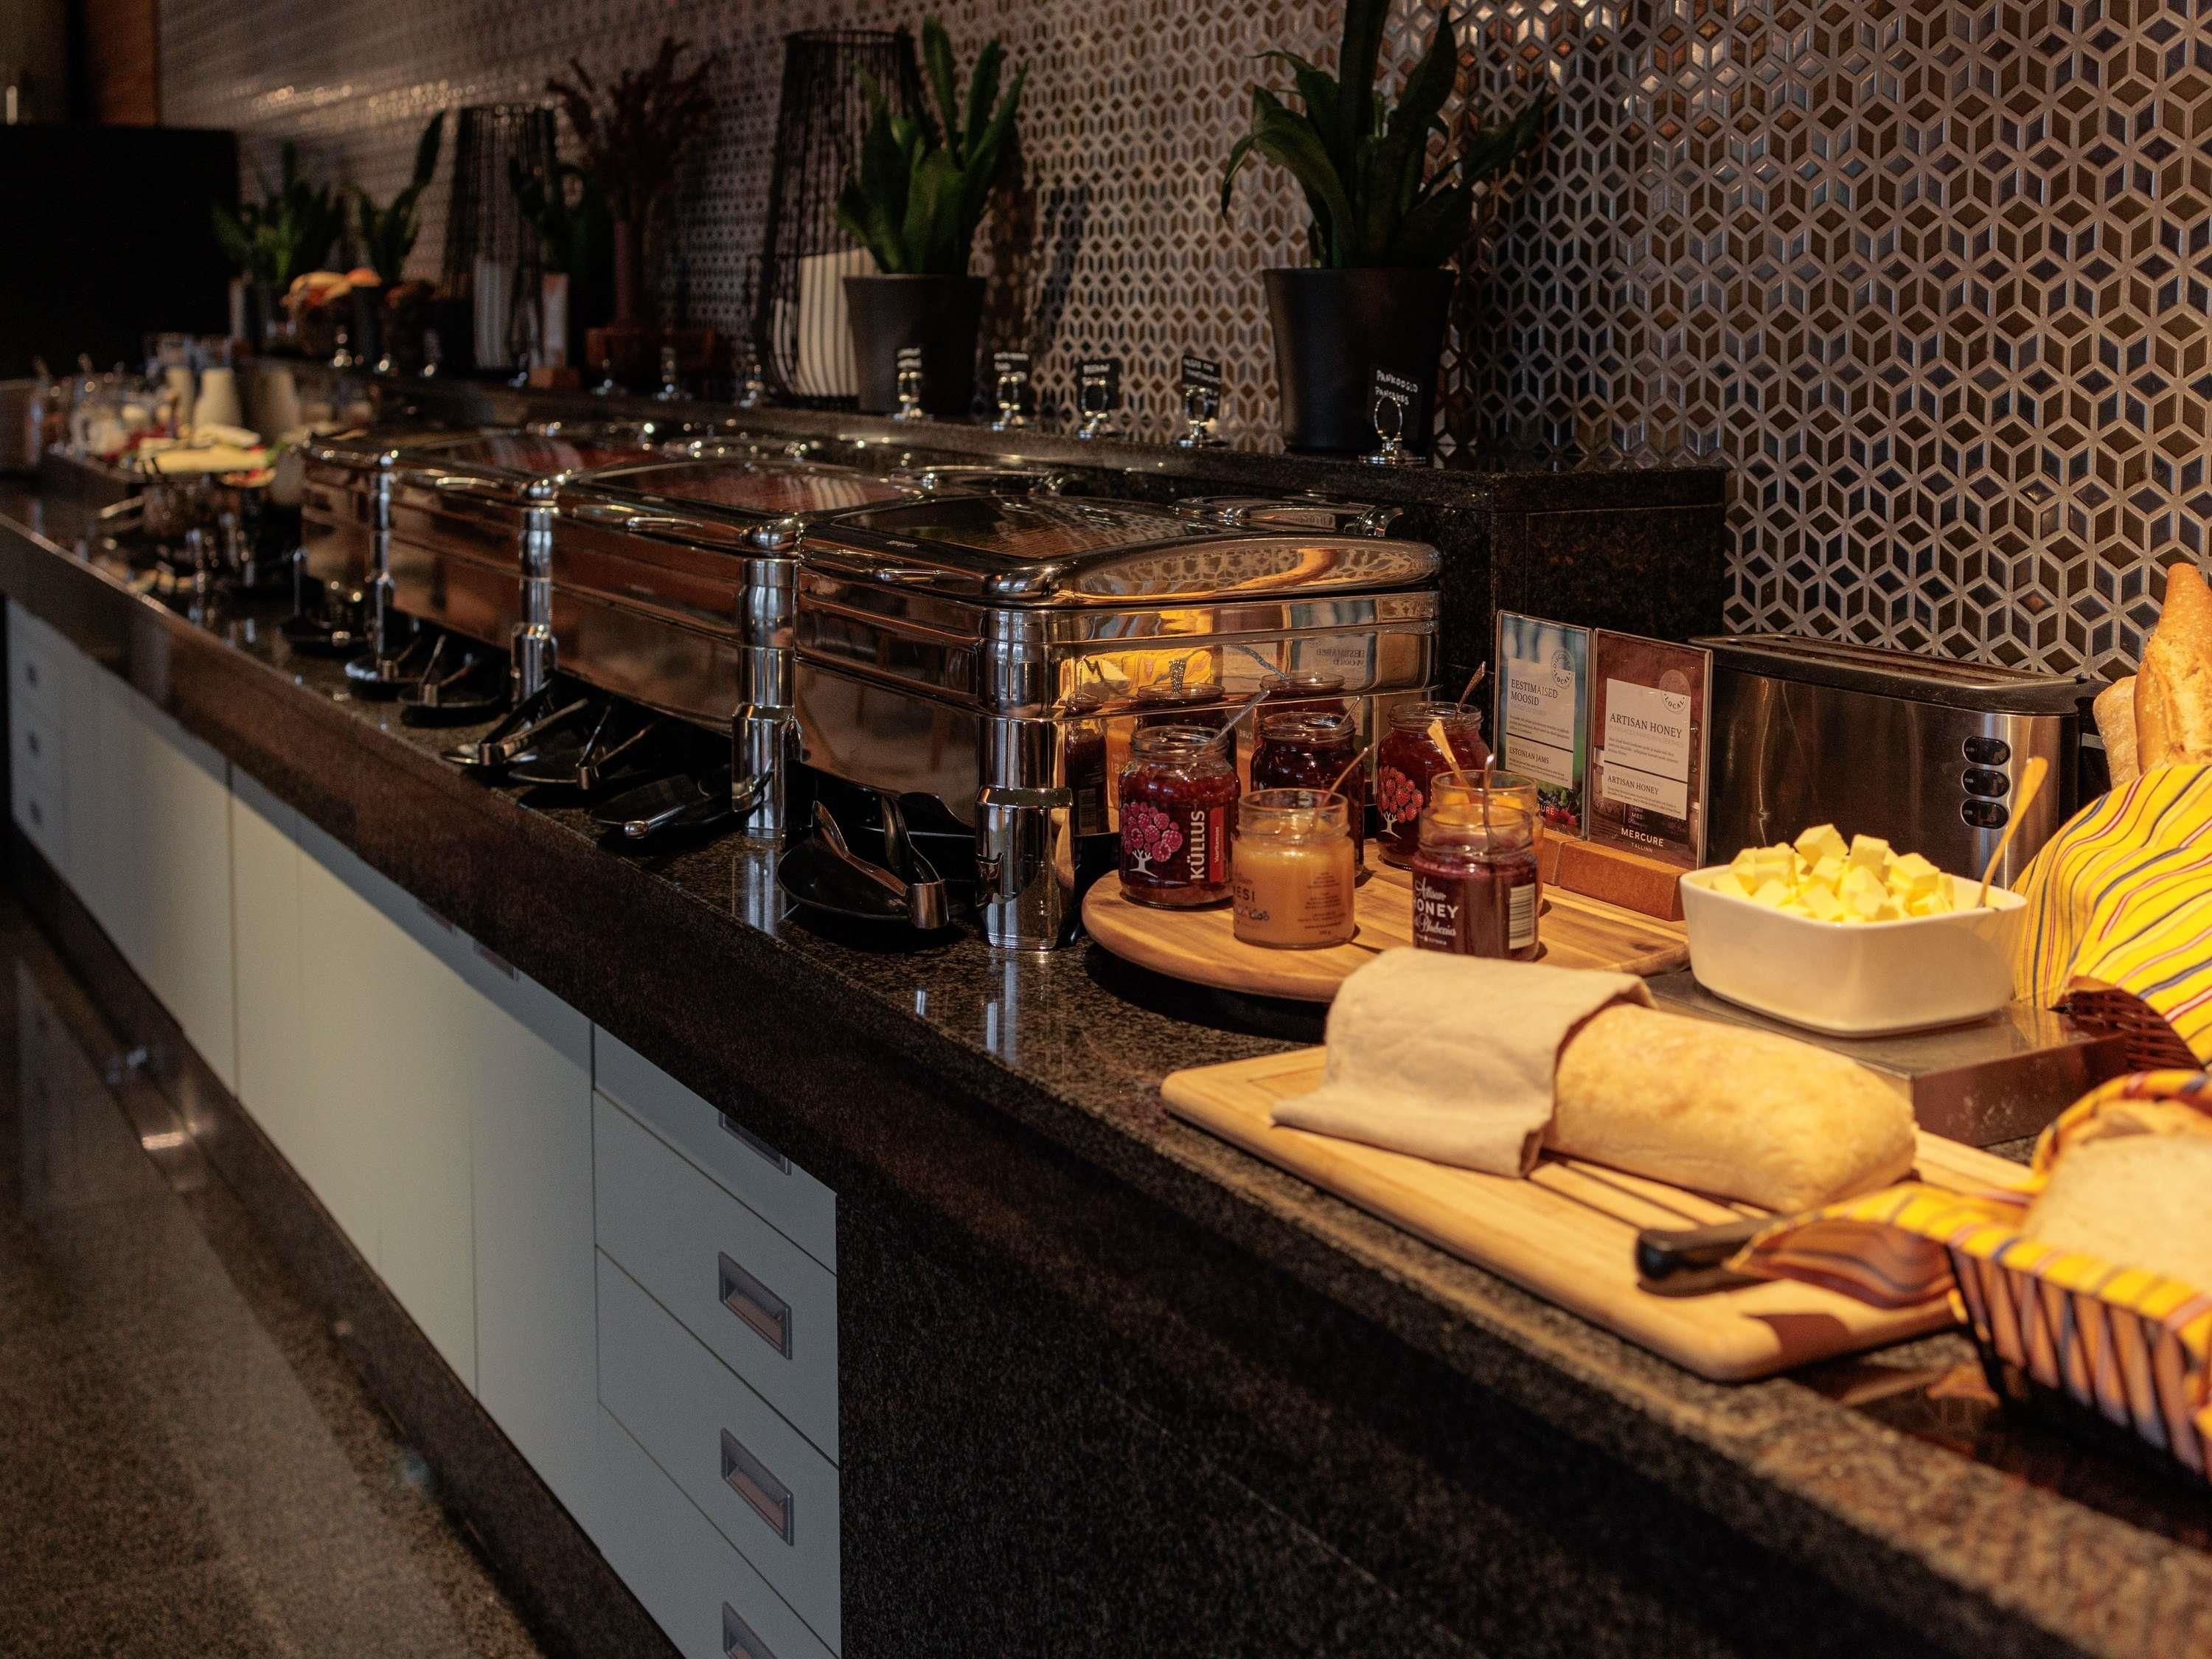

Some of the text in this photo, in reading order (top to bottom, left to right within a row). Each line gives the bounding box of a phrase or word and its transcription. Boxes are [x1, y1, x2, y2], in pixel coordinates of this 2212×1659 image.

[1511, 678, 1558, 698] EESTIMAISED
[1554, 672, 1571, 685] LOCAL
[1511, 691, 1540, 706] MOOSID
[1664, 696, 1684, 709] LOCAL
[1610, 713, 1647, 730] ARTISAN
[1650, 722, 1682, 738] HONEY
[1509, 746, 1549, 764] ESTONIAN JAMS
[1607, 775, 1659, 795] ARTISAN HONEY
[1186, 810, 1205, 880] KÜLLUS
[1621, 827, 1664, 847] MERCURE
[1233, 886, 1255, 902] ESI
